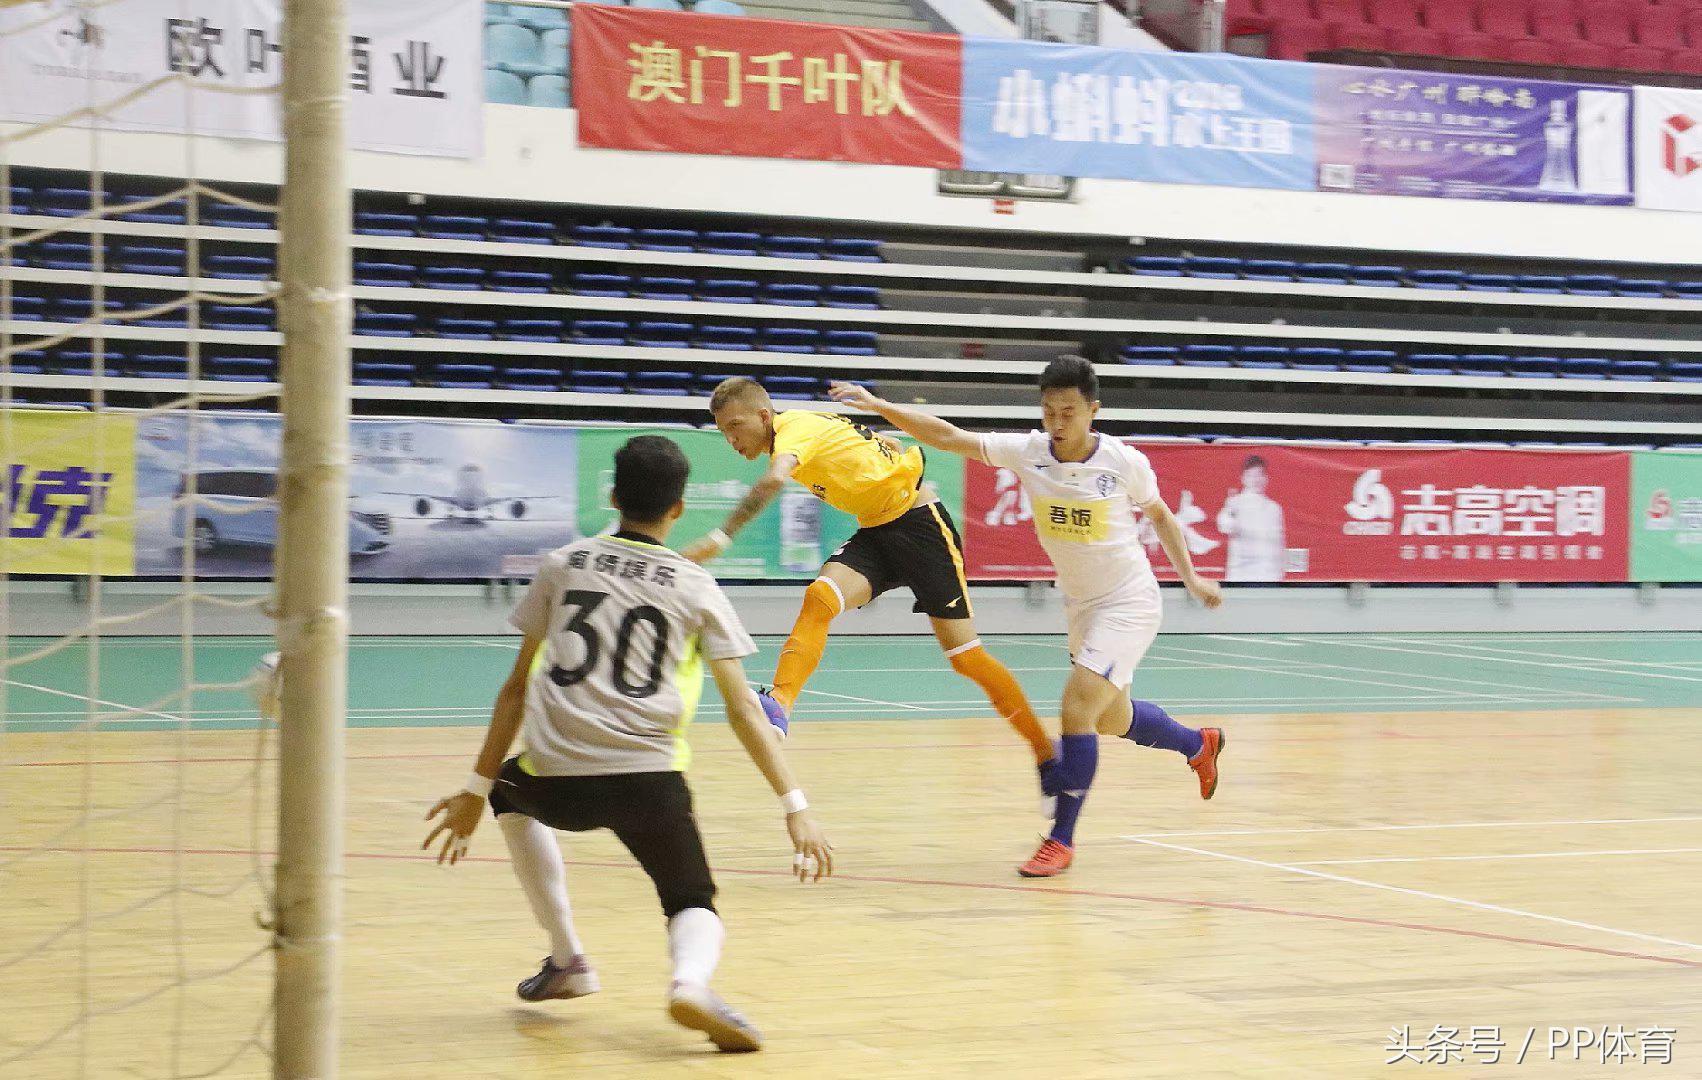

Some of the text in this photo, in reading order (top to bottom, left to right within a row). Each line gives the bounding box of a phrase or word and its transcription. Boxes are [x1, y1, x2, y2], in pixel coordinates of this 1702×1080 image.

[626, 40, 918, 117] 澳门千叶队
[1049, 505, 1091, 527] 吾饭
[1400, 484, 1606, 536] 志高空调
[550, 589, 670, 699] 30
